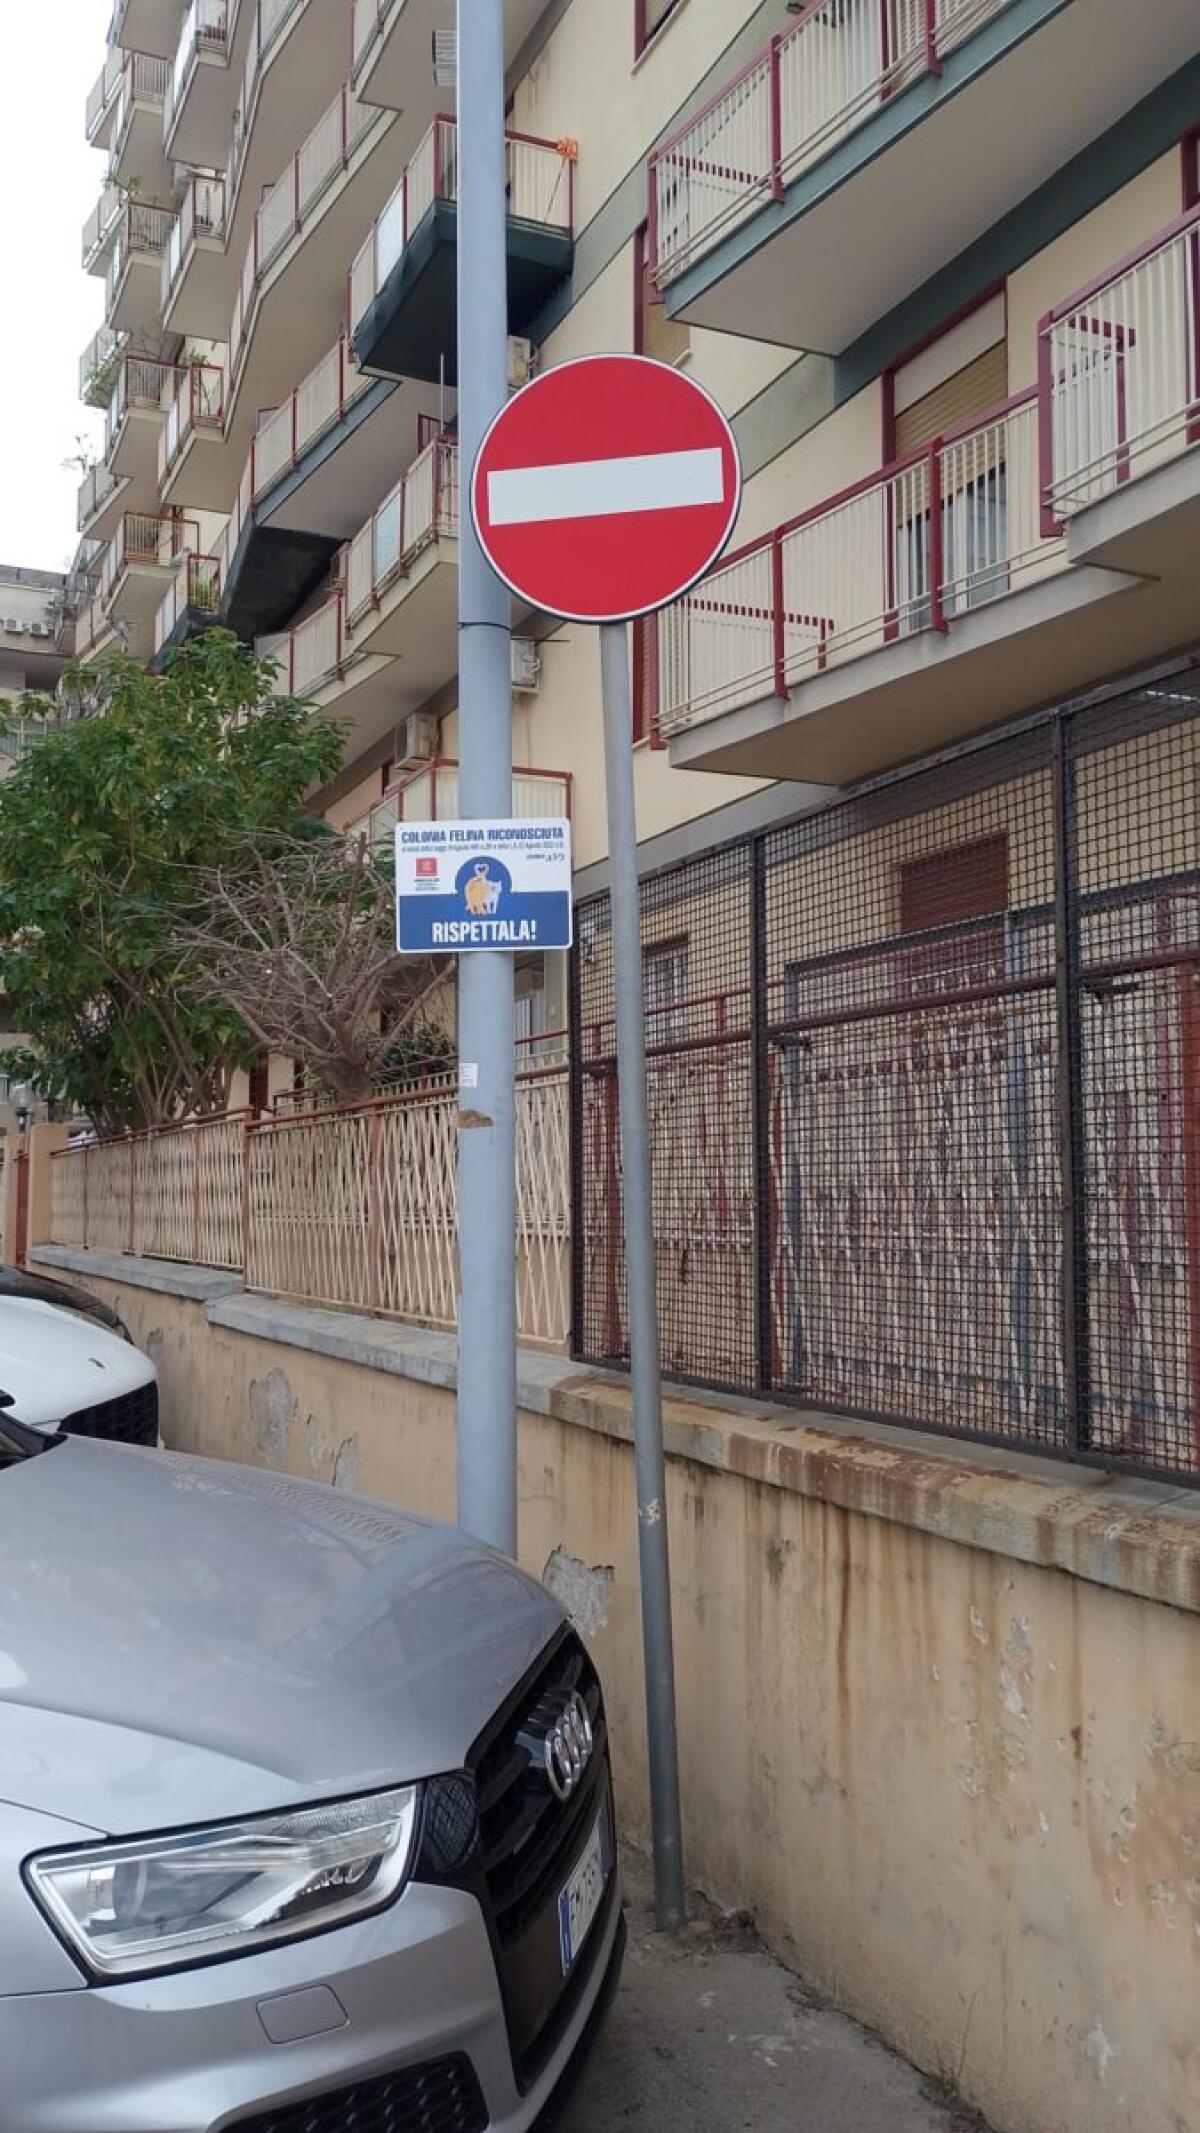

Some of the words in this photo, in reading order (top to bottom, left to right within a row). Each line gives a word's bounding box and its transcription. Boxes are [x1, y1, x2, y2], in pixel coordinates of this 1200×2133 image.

[401, 830, 446, 843] COLONIA
[449, 829, 484, 841] FELINA
[488, 826, 565, 841] RICONOSCIUTA
[433, 921, 536, 942] RISPETTALA!
